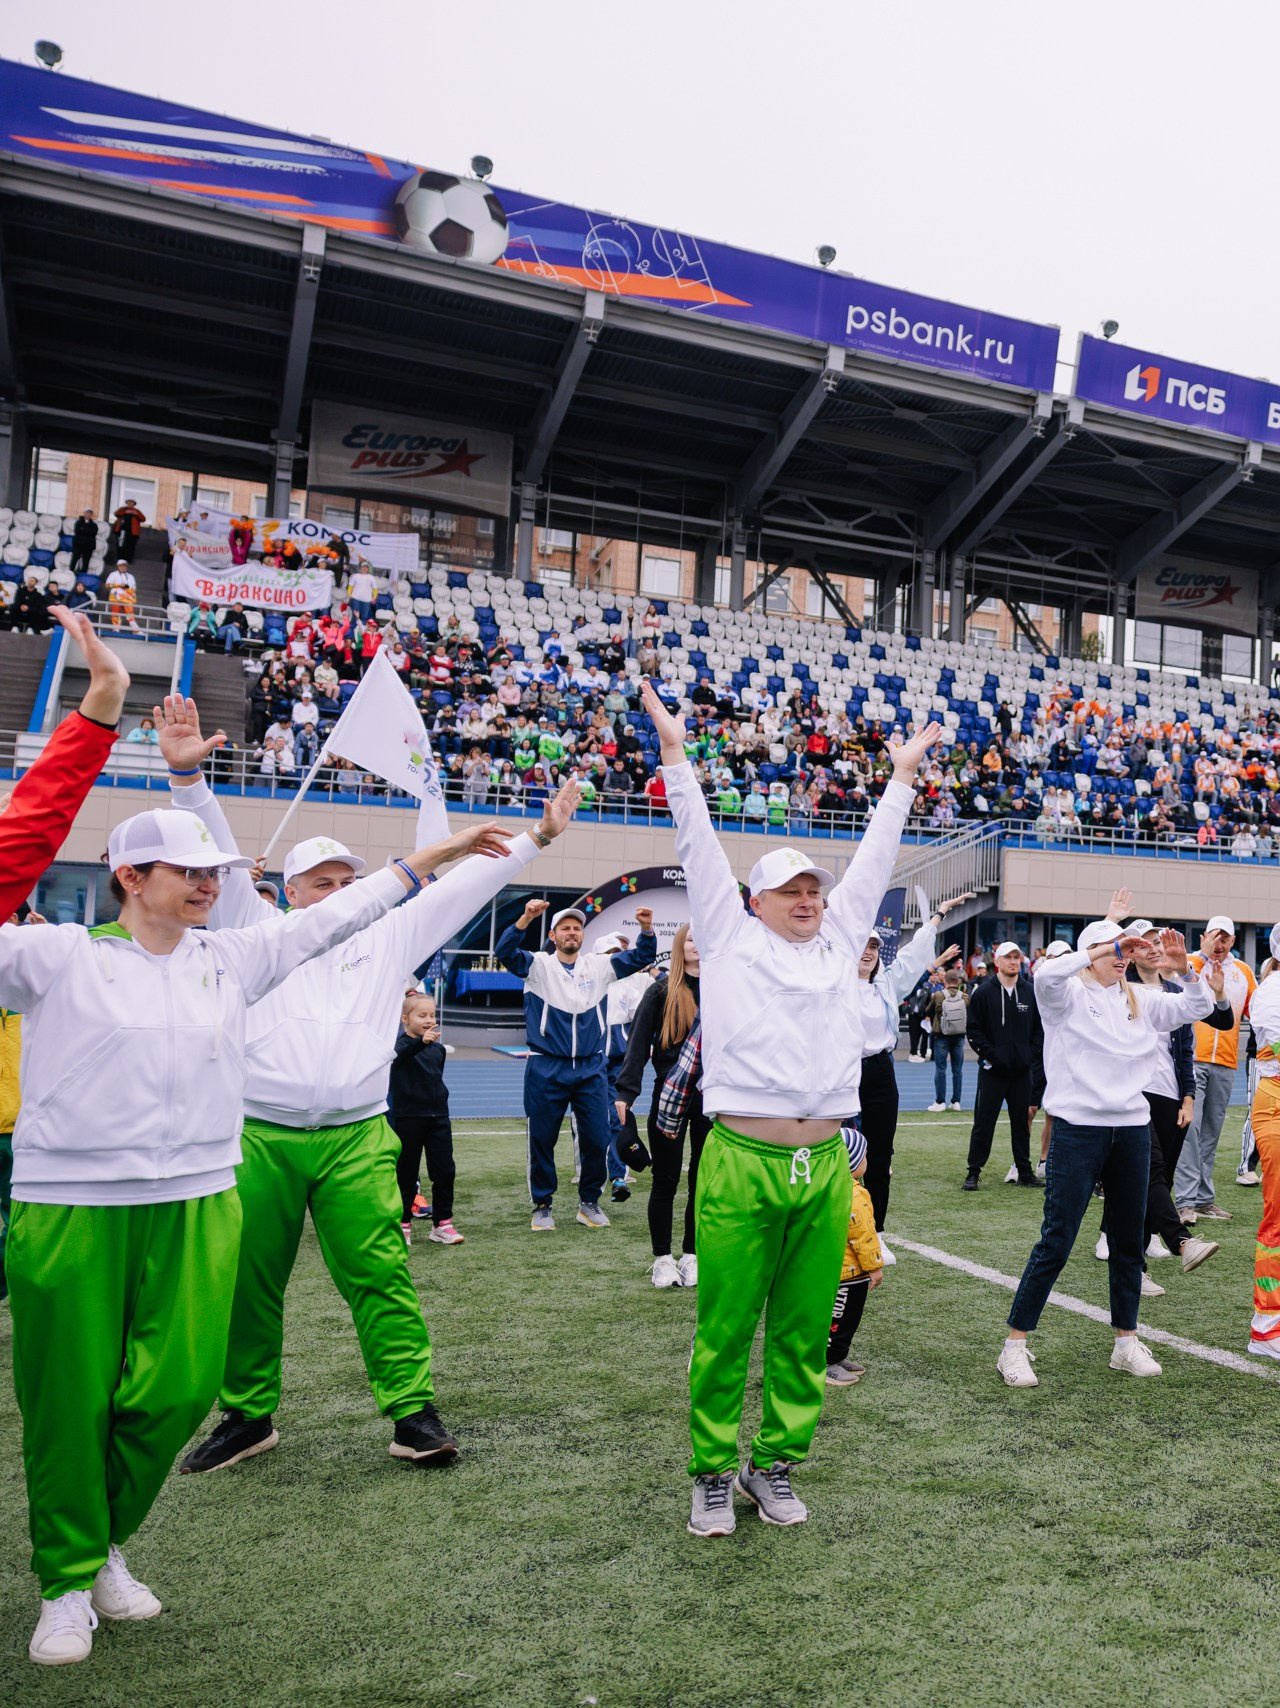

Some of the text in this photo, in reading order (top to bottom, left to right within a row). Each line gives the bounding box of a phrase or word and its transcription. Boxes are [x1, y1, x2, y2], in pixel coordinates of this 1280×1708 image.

[846, 303, 1015, 366] psbank.ru
[1165, 378, 1226, 415] ПСБ
[663, 869, 686, 880] КОМ
